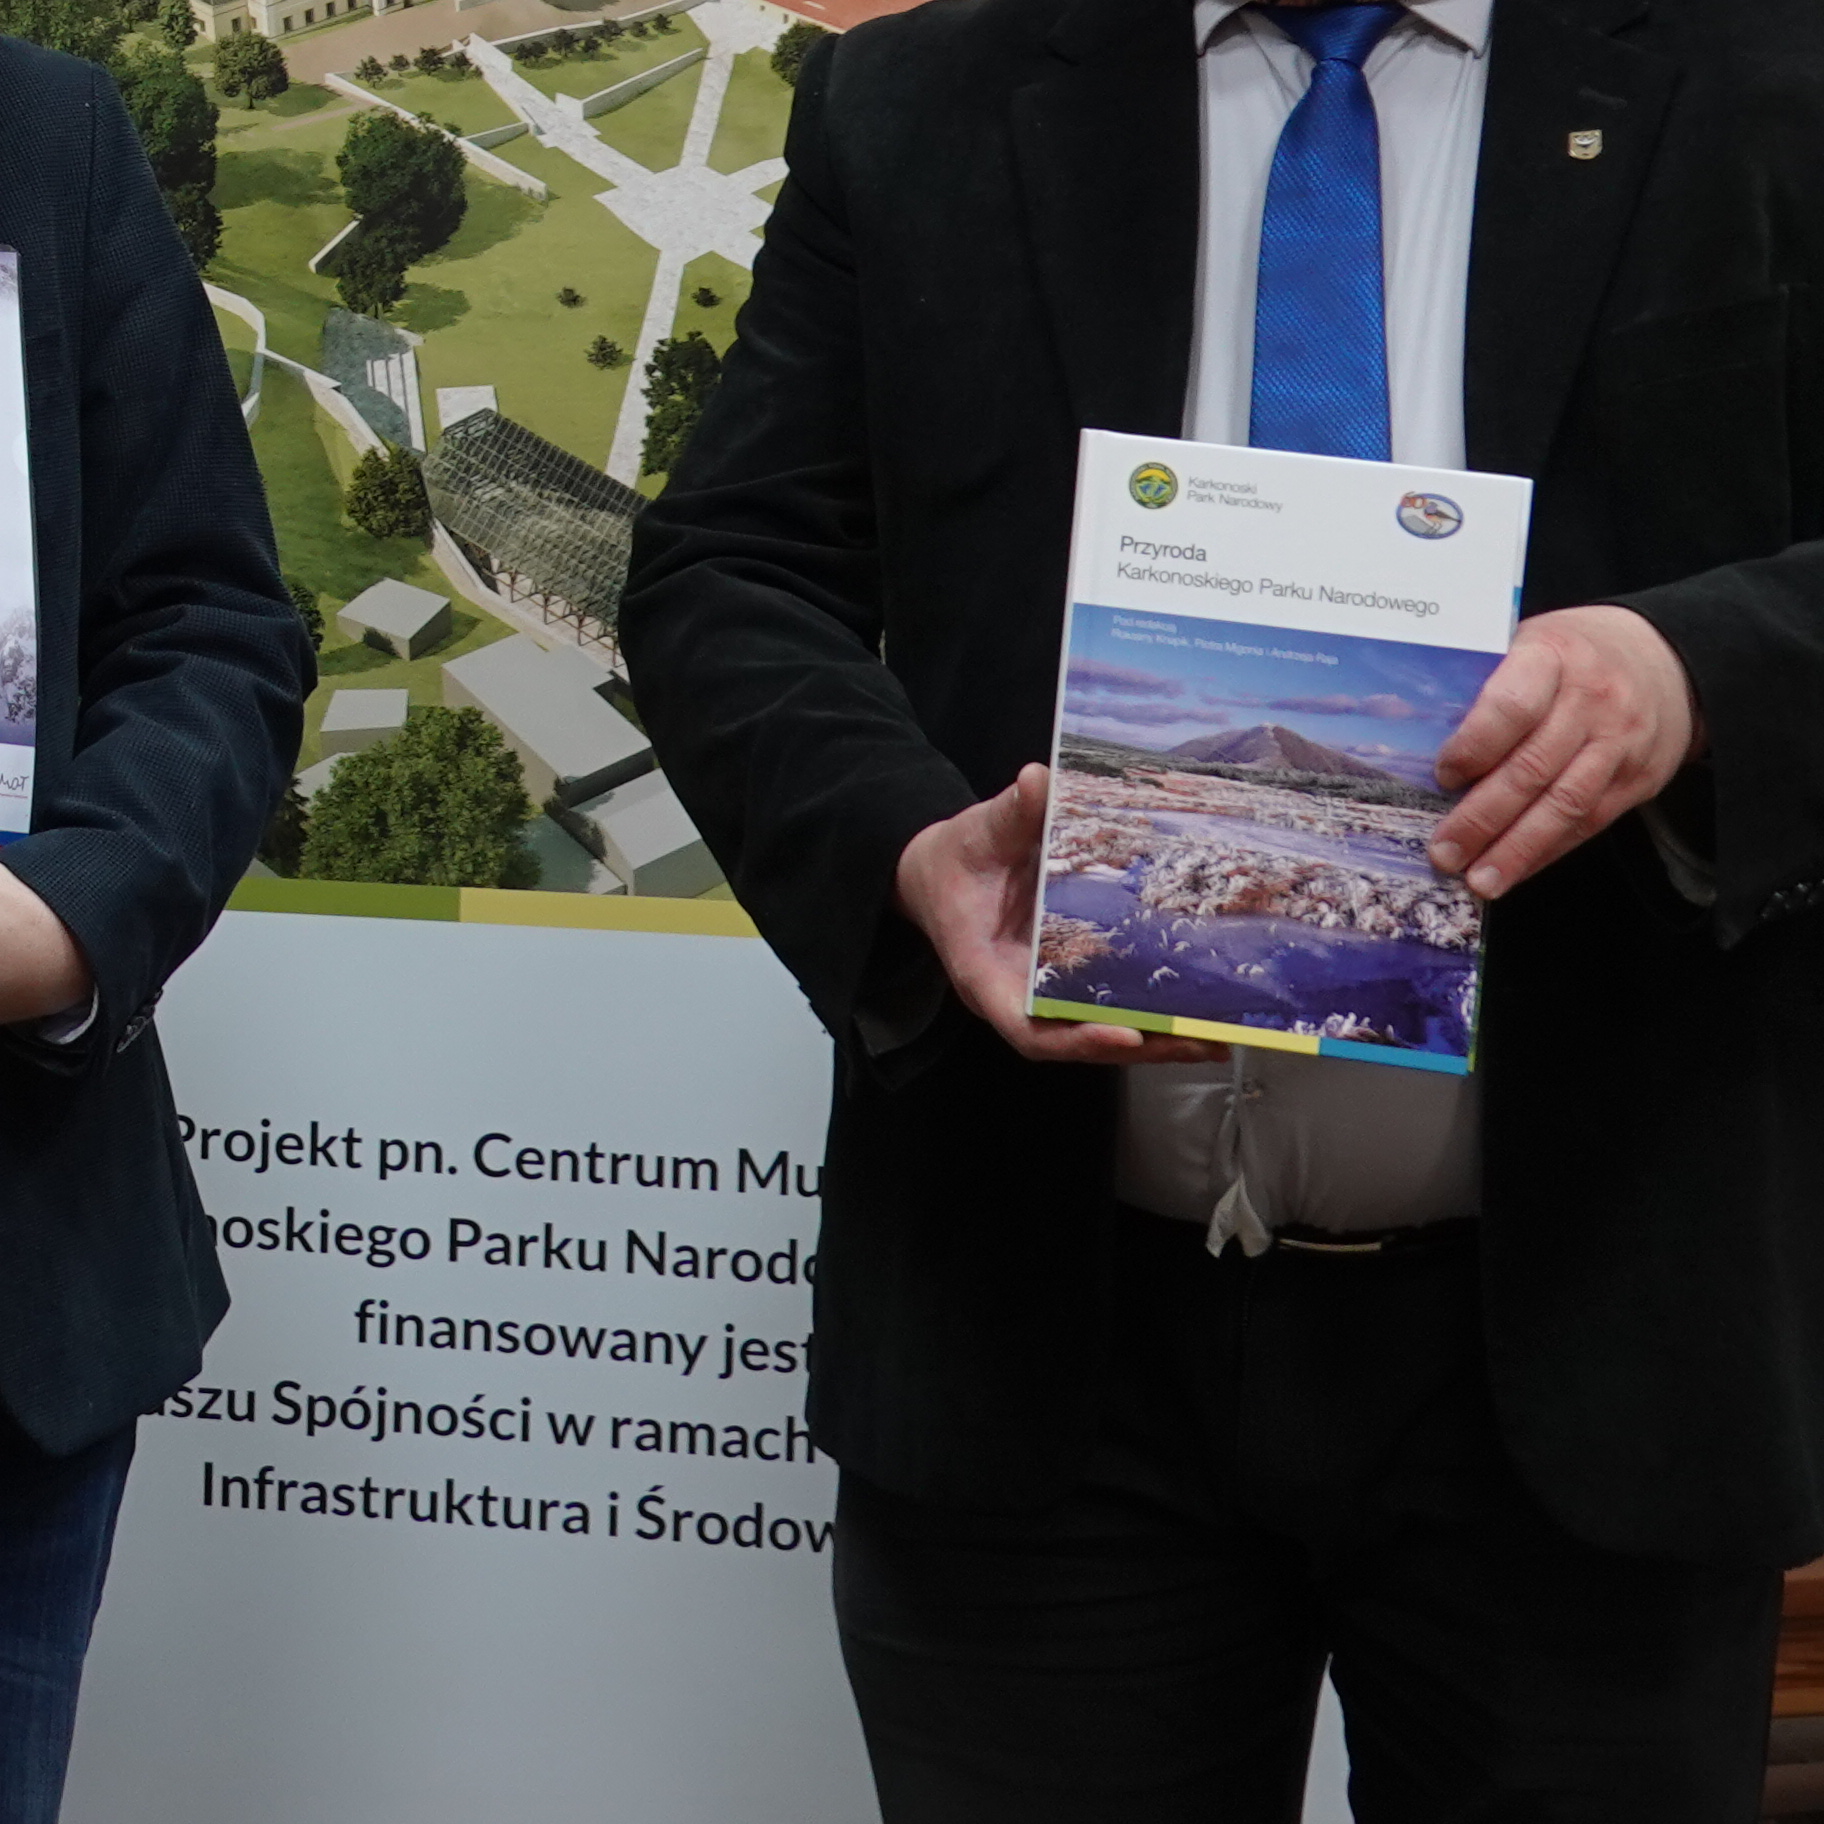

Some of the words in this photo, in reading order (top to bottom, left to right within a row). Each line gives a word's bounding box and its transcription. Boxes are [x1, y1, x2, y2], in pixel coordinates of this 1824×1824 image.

[1187, 490, 1215, 503] Park
[1219, 493, 1283, 513] Narodowy
[1120, 536, 1207, 562] Przyroda
[1117, 562, 1253, 596] Karkonoskiego
[1259, 578, 1313, 600] Parku
[1319, 585, 1440, 618] Narodowego
[379, 1138, 458, 1181] pn.
[473, 1132, 719, 1191] Centrum
[448, 1218, 607, 1272] Parku
[354, 1299, 708, 1377] finansowany
[271, 1380, 532, 1442] Spójności
[546, 1412, 596, 1446] w
[610, 1404, 817, 1463] ramach
[203, 1462, 590, 1535] Infrastruktura
[608, 1491, 619, 1537] i
